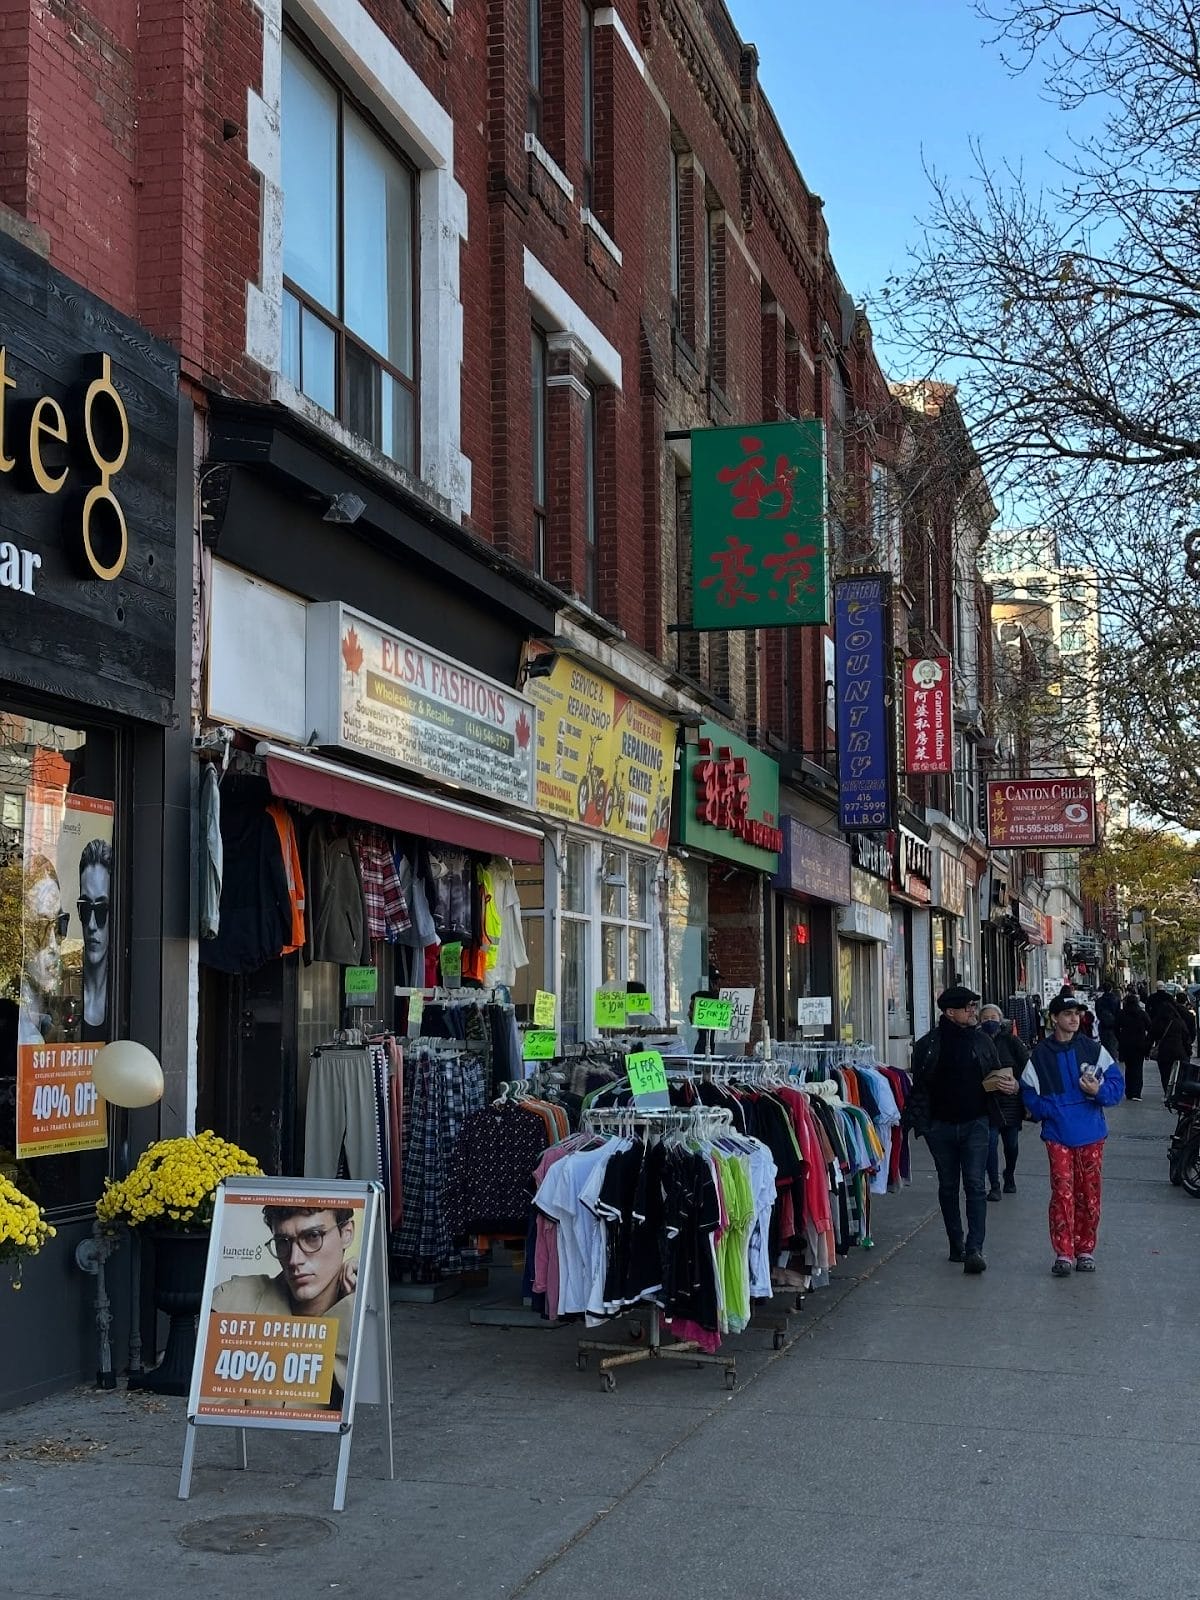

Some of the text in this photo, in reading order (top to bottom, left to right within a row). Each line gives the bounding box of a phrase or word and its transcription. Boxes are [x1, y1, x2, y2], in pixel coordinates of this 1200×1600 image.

[382, 637, 427, 690] ELSA
[431, 661, 505, 725] FASHIONS
[571, 670, 599, 701] SERVICE
[598, 686, 604, 703] &
[845, 604, 873, 777] COUNTRY
[374, 680, 416, 711] Wholesaler
[418, 700, 425, 714] &
[356, 700, 389, 724] Souvenirs
[567, 695, 590, 723] REPAIR
[590, 707, 611, 731] SHOP
[343, 711, 362, 729] Suits
[367, 721, 393, 740] Blazers
[397, 731, 417, 749] Brand
[418, 740, 437, 756] Name
[437, 748, 460, 768] Clothing
[343, 727, 396, 757] Undergarments
[402, 749, 422, 766] Towels
[427, 758, 440, 773] Kids
[622, 731, 663, 772] REPAIRING
[629, 765, 652, 794] CENTRE
[1005, 785, 1049, 801] CANTON
[844, 801, 885, 810] 977-5999
[612, 992, 625, 1000] SALE
[697, 1008, 707, 1020] 5
[33, 1050, 56, 1069] SOFT
[640, 1057, 661, 1073] FOR
[32, 1083, 71, 1120] 40%
[40, 1125, 49, 1133] ALL
[50, 1123, 68, 1132] FRAMES
[72, 1120, 99, 1129] SUNGLASSES
[220, 1319, 327, 1340] SOFT OPENING
[215, 1349, 324, 1385] 40% OFF
[239, 1387, 266, 1395] FRAMES
[275, 1389, 320, 1398] SUNGLASSES
